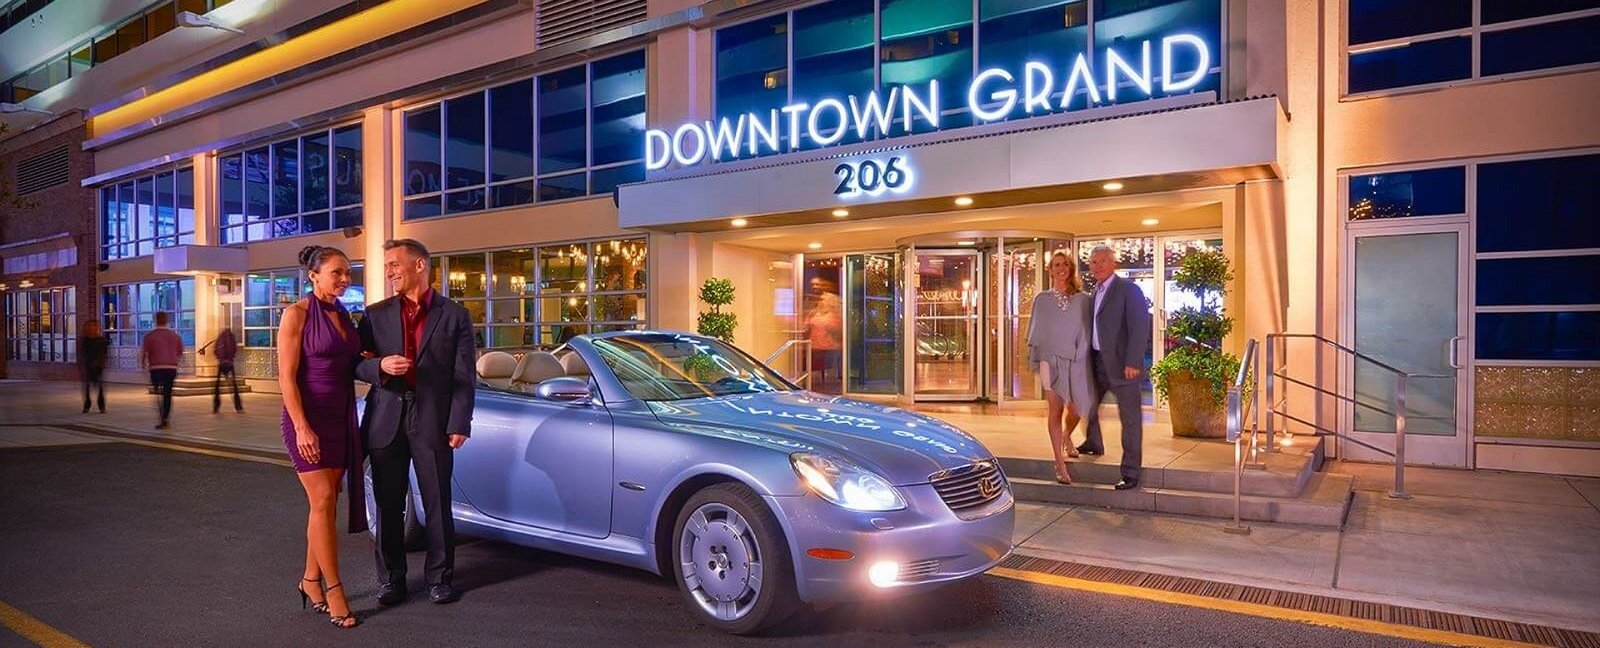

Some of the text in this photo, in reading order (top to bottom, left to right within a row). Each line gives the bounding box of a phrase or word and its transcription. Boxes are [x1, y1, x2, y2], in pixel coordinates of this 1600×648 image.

[645, 33, 1211, 171] DOWNTOWN GRAND
[833, 157, 907, 195] 206
